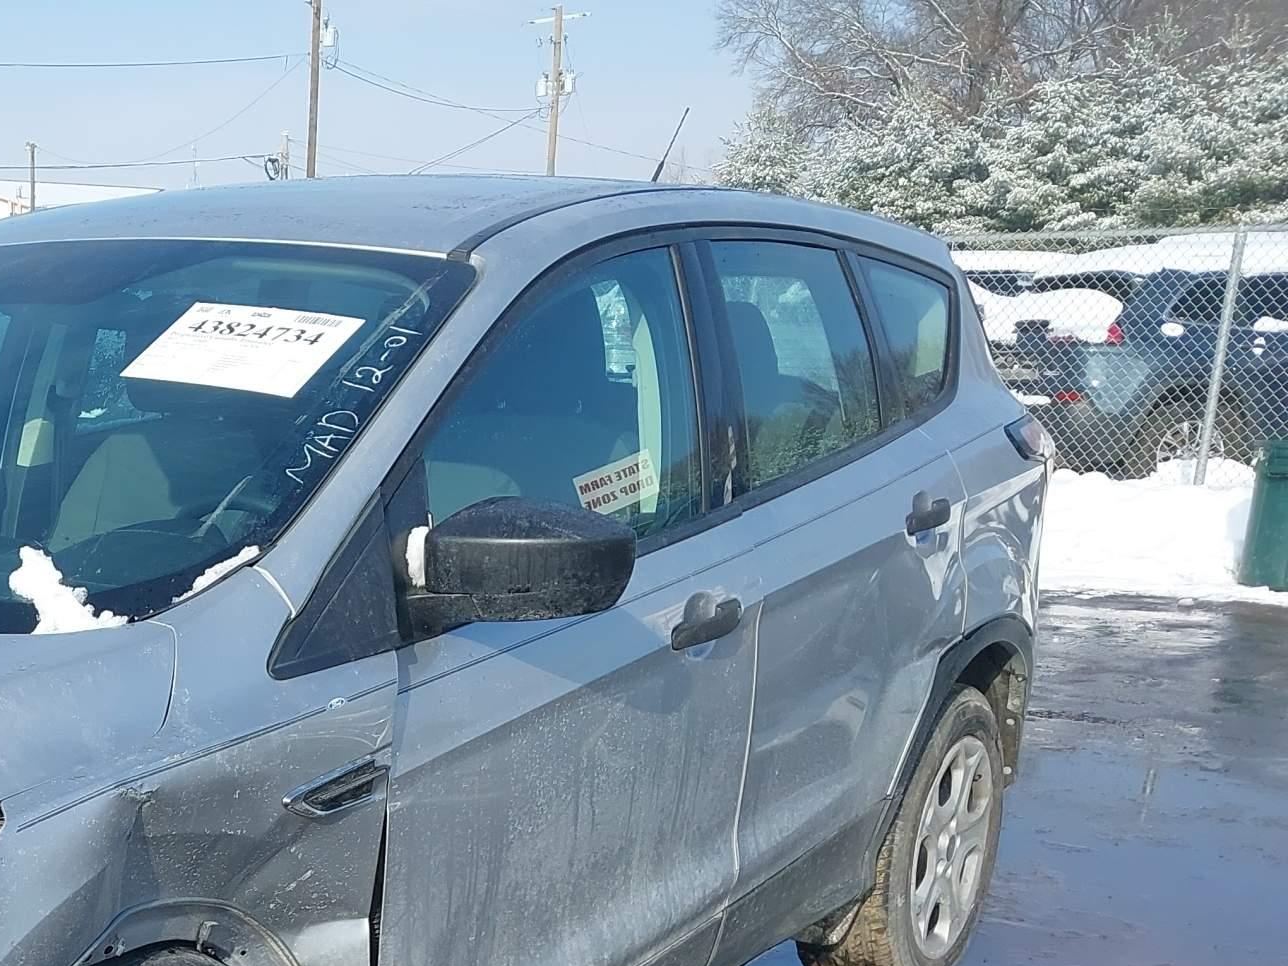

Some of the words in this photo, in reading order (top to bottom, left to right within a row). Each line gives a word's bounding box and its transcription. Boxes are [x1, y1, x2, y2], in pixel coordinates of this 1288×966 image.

[187, 318, 325, 346] 43824734
[285, 410, 360, 485] MAD
[341, 325, 423, 393] 12-01
